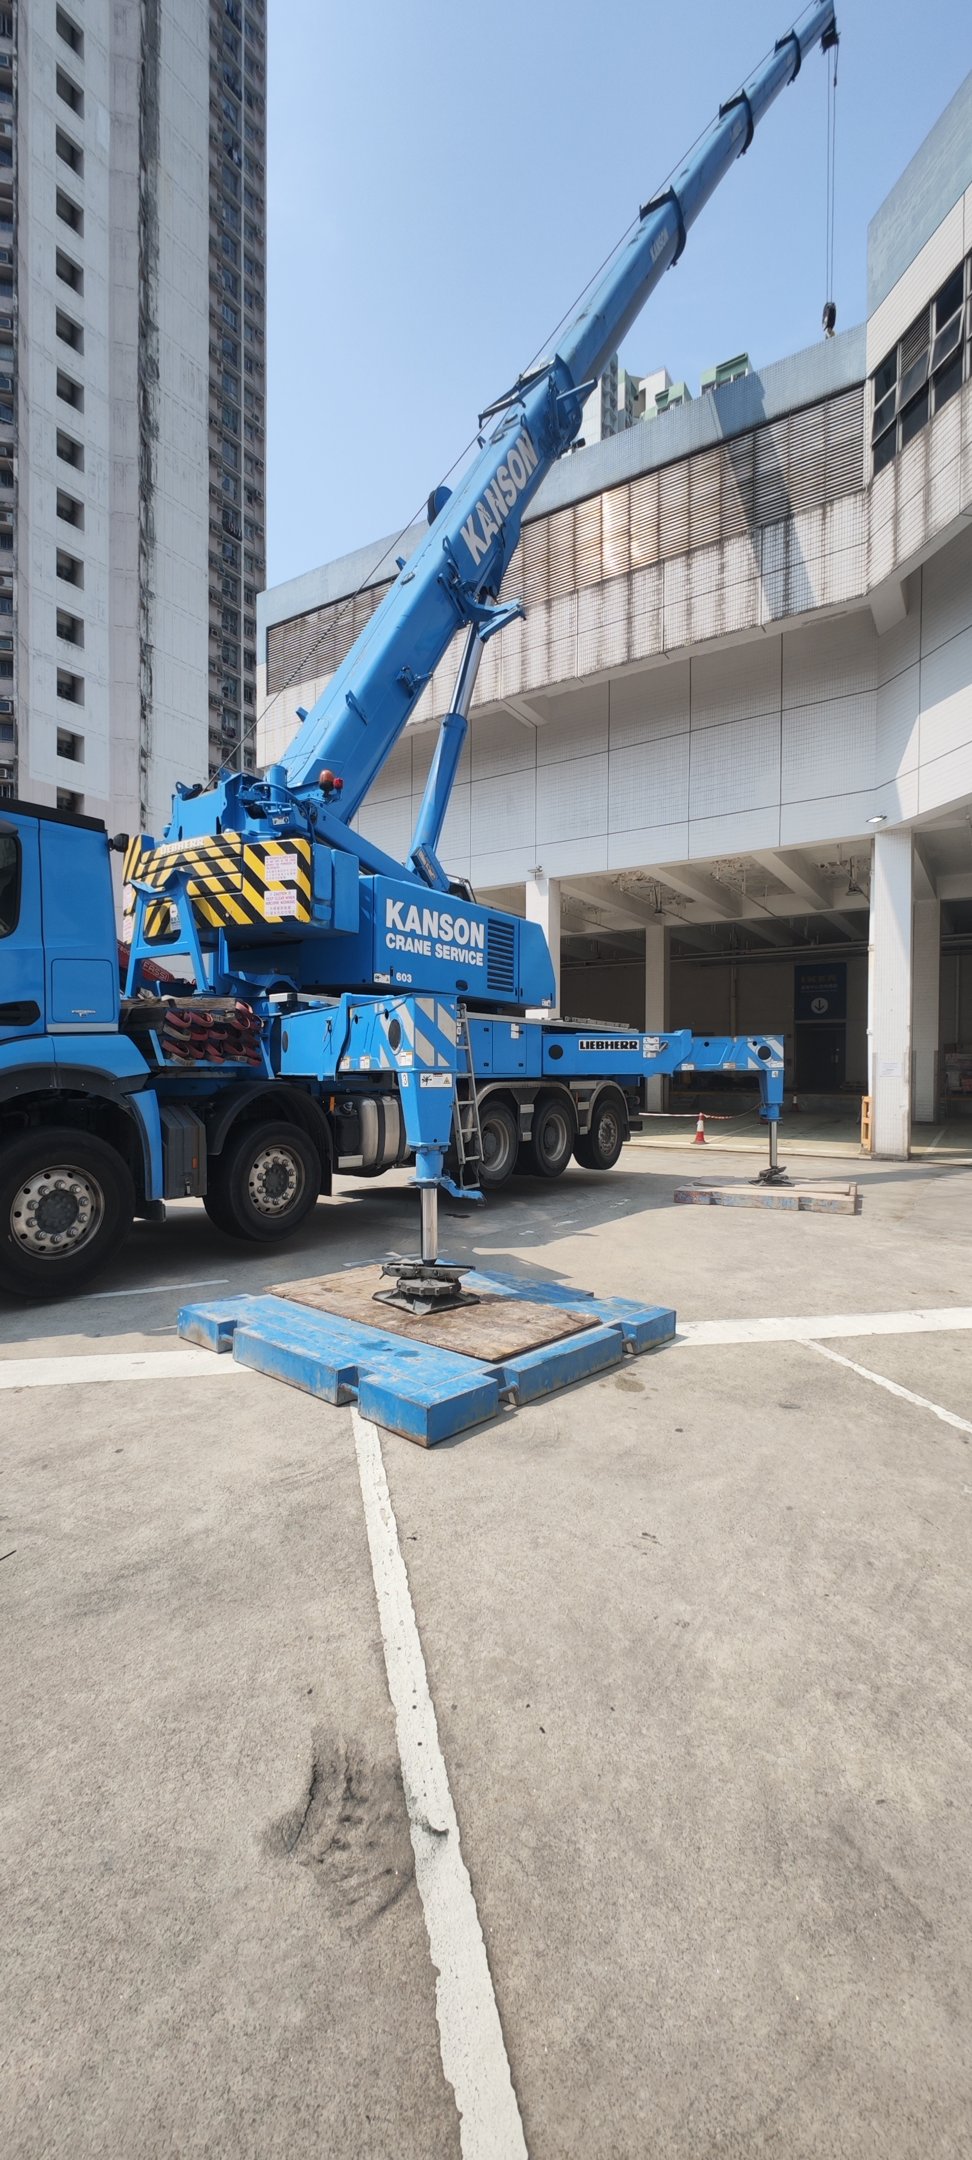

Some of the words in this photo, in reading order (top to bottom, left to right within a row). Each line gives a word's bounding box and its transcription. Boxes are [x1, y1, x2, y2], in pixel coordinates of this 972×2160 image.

[460, 429, 538, 566] KANSON
[386, 898, 485, 950] KANSON
[386, 932, 432, 957] CRANE
[435, 943, 484, 967] SERVICE
[396, 972, 412, 983] 603
[579, 1040, 638, 1050] LIEBHERR
